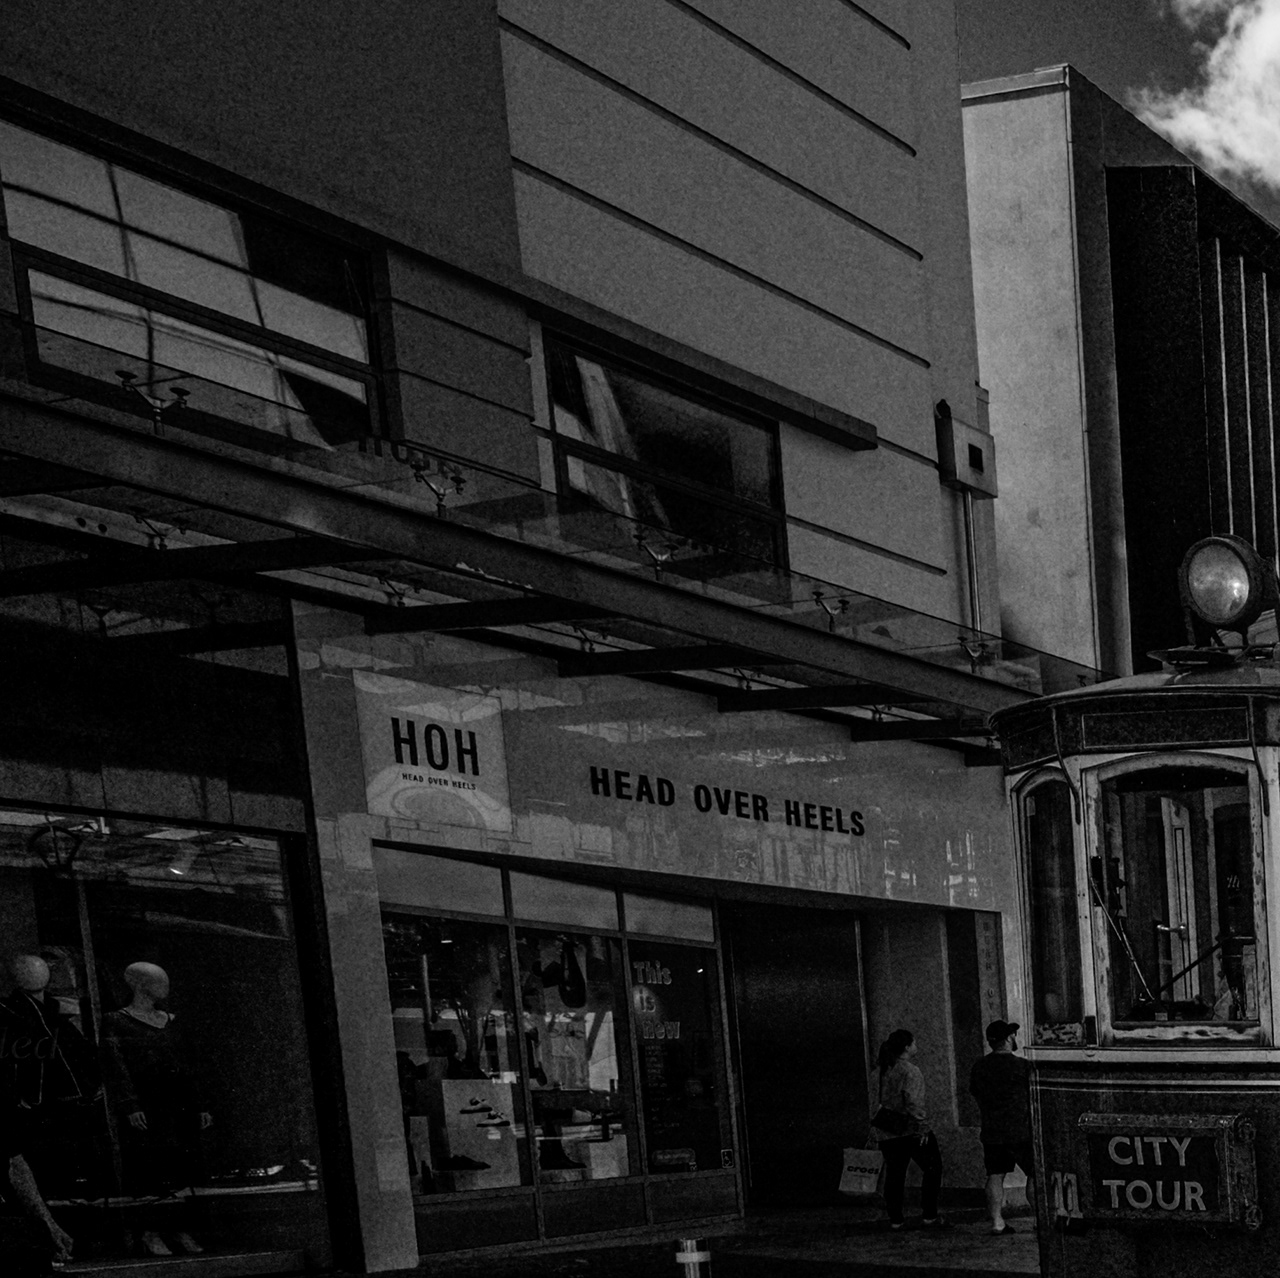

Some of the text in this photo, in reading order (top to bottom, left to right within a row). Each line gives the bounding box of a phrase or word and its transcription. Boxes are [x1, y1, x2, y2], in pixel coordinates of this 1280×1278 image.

[391, 717, 481, 776] HOH
[402, 772, 477, 791] HEAD OVER HEELS
[590, 766, 865, 836] HEAD OVER HEELS
[633, 960, 673, 985] This
[638, 990, 656, 1013] is
[1107, 1136, 1192, 1167] CITY
[847, 1165, 879, 1175] crocs
[1102, 1179, 1207, 1212] TOUR
